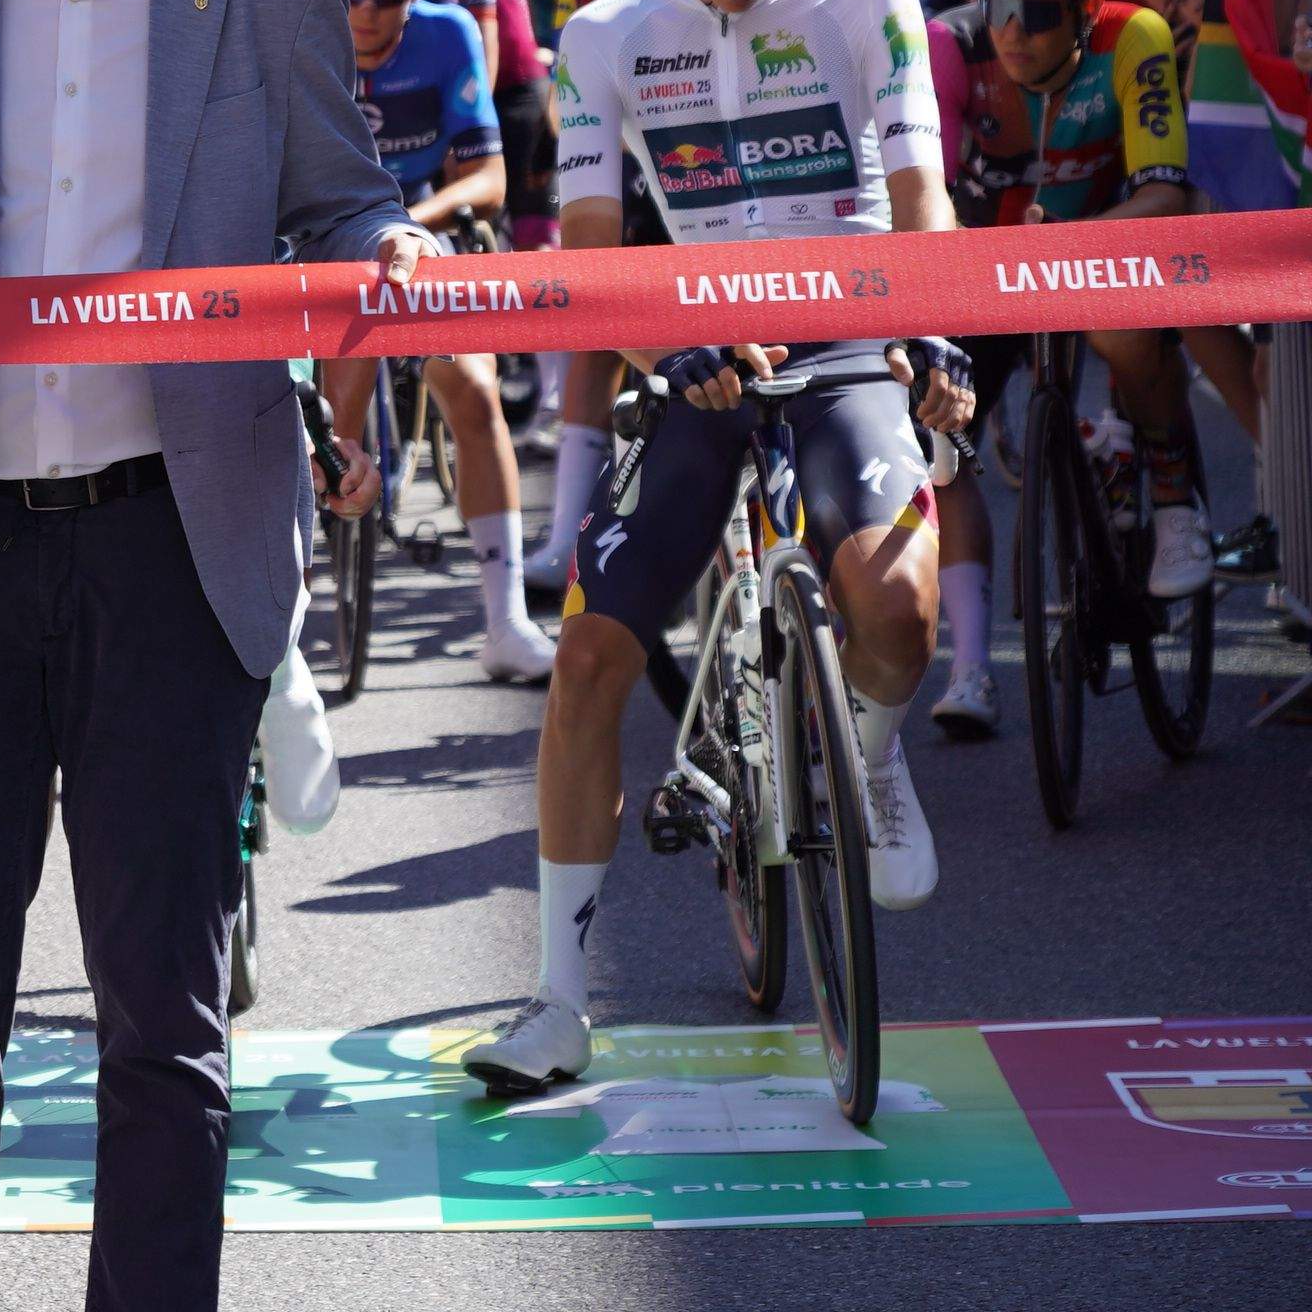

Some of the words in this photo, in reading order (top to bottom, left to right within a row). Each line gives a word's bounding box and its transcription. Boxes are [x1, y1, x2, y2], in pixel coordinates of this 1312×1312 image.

[634, 49, 712, 77] Santini
[640, 87, 655, 101] LA
[655, 81, 695, 100] VUELTA
[697, 79, 712, 94] 25
[747, 81, 830, 104] plenitude
[739, 129, 847, 165] BORA
[747, 154, 848, 181] hansgrohe
[676, 276, 718, 305] LA
[719, 271, 844, 303] VUELTA
[849, 269, 890, 298] 25
[996, 263, 1038, 293] LA
[1039, 257, 1165, 291] VUELTA
[1170, 254, 1210, 285] 25
[30, 297, 69, 325] LA
[73, 291, 195, 324] VUELTA
[202, 289, 241, 319] 25
[358, 283, 398, 315] LA
[401, 280, 524, 314] VUELTA
[531, 279, 570, 309] 25
[614, 437, 645, 495] SRAM
[625, 1045, 788, 1060] VUELTA
[1127, 1038, 1182, 1050] LA
[673, 1178, 972, 1195] plenitude
